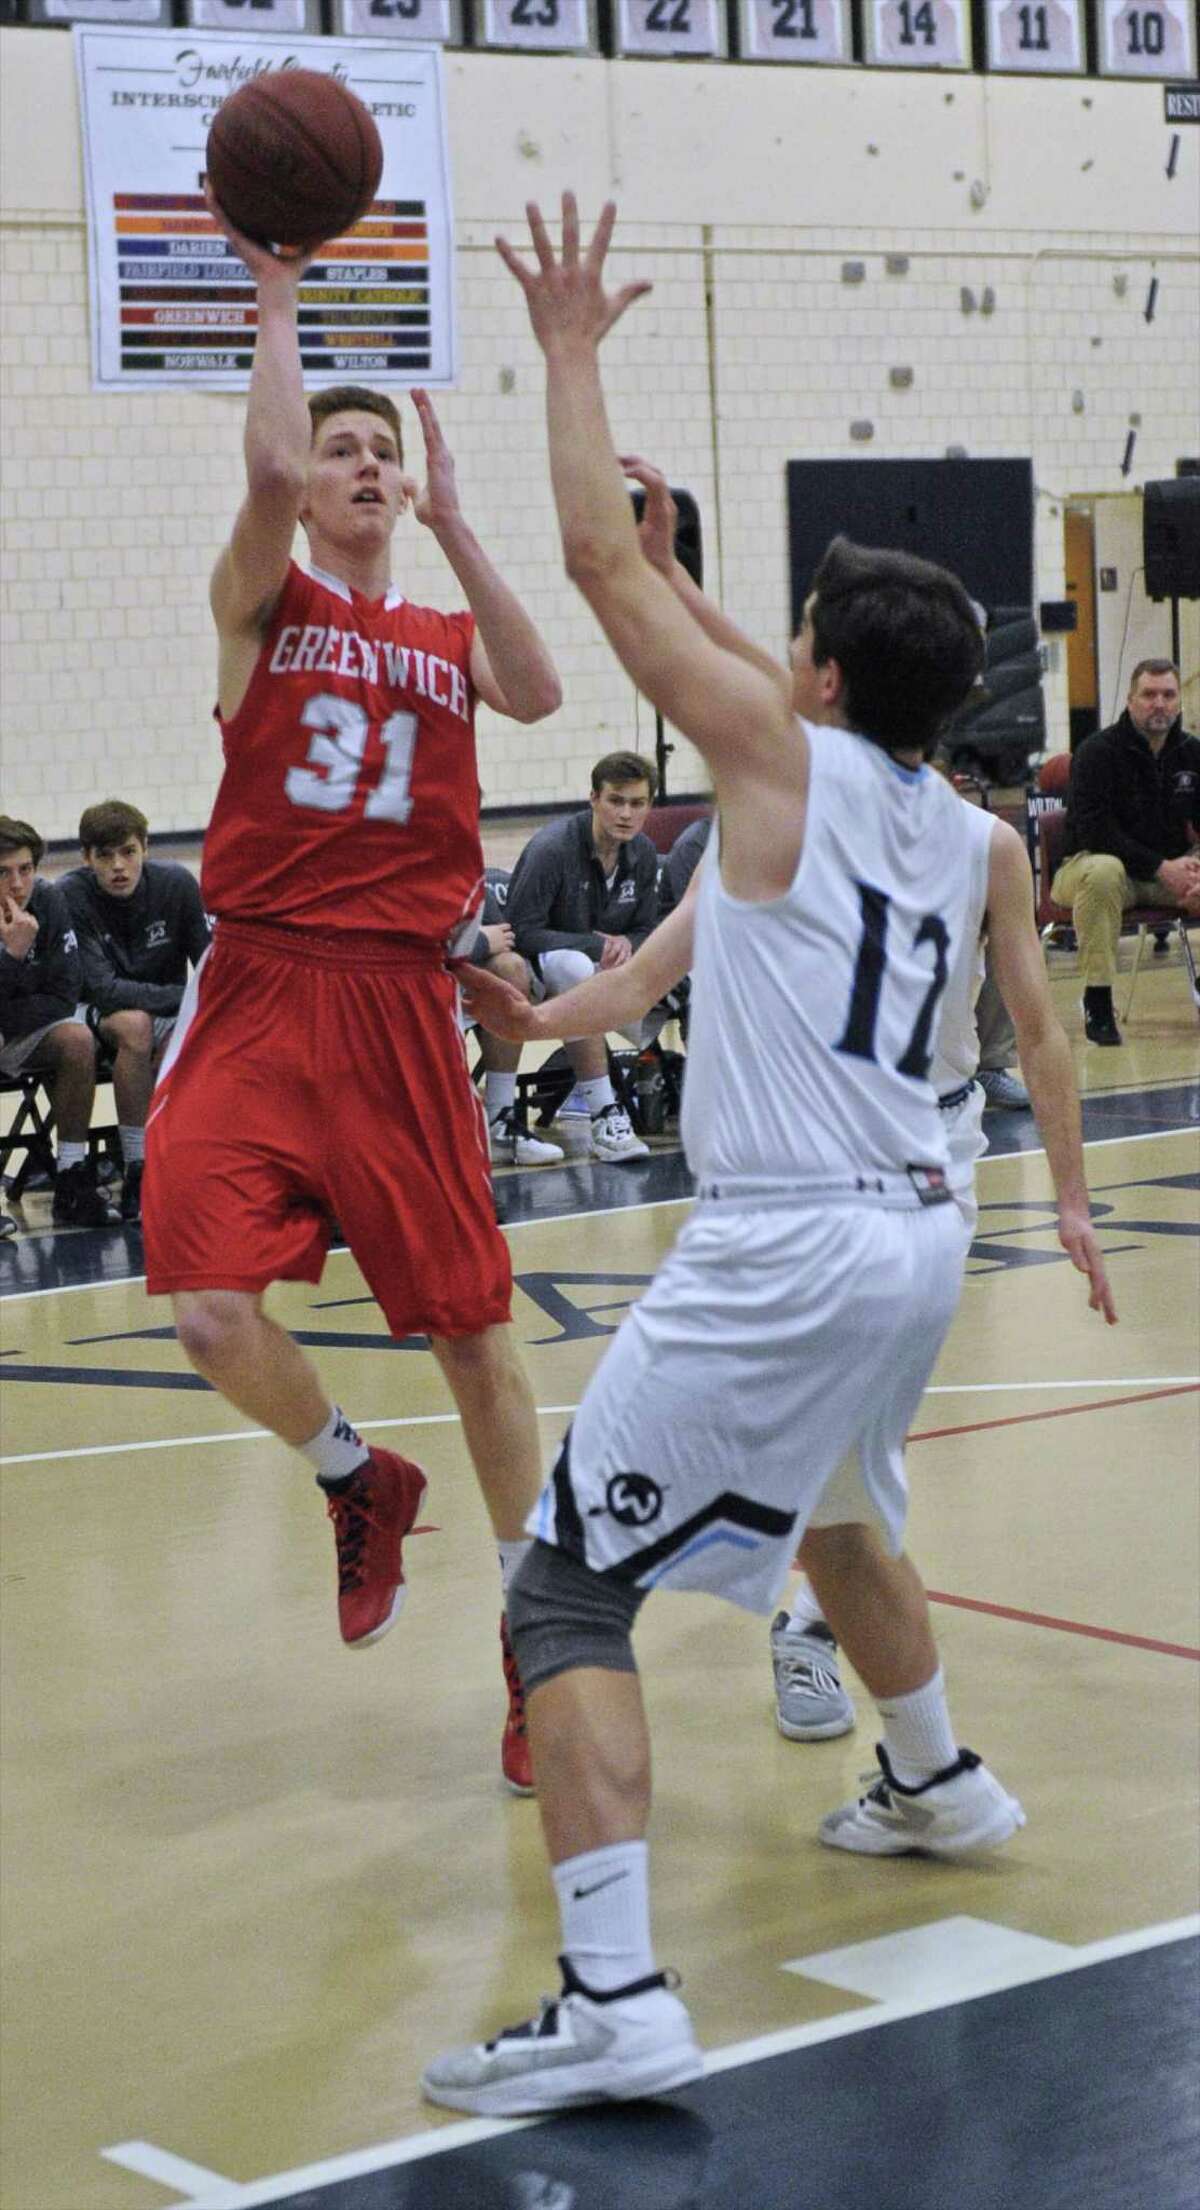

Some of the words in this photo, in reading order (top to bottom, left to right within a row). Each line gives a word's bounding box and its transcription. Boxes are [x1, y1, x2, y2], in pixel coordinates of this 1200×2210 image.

[772, 0, 818, 39] 21
[898, 0, 936, 45] 14
[1019, 5, 1049, 50] 11
[1128, 11, 1164, 54] 10
[112, 91, 224, 108] INTERSCH
[371, 102, 416, 117] ETIC
[168, 240, 227, 256] DARIEN
[203, 263, 249, 279] LUDLO
[326, 267, 388, 281] STAPLES
[153, 307, 246, 324] GREENWICH
[163, 353, 239, 370] NORWALK
[333, 354, 388, 369] WILTON
[269, 625, 469, 723] GREENWICH
[284, 692, 418, 825] 31
